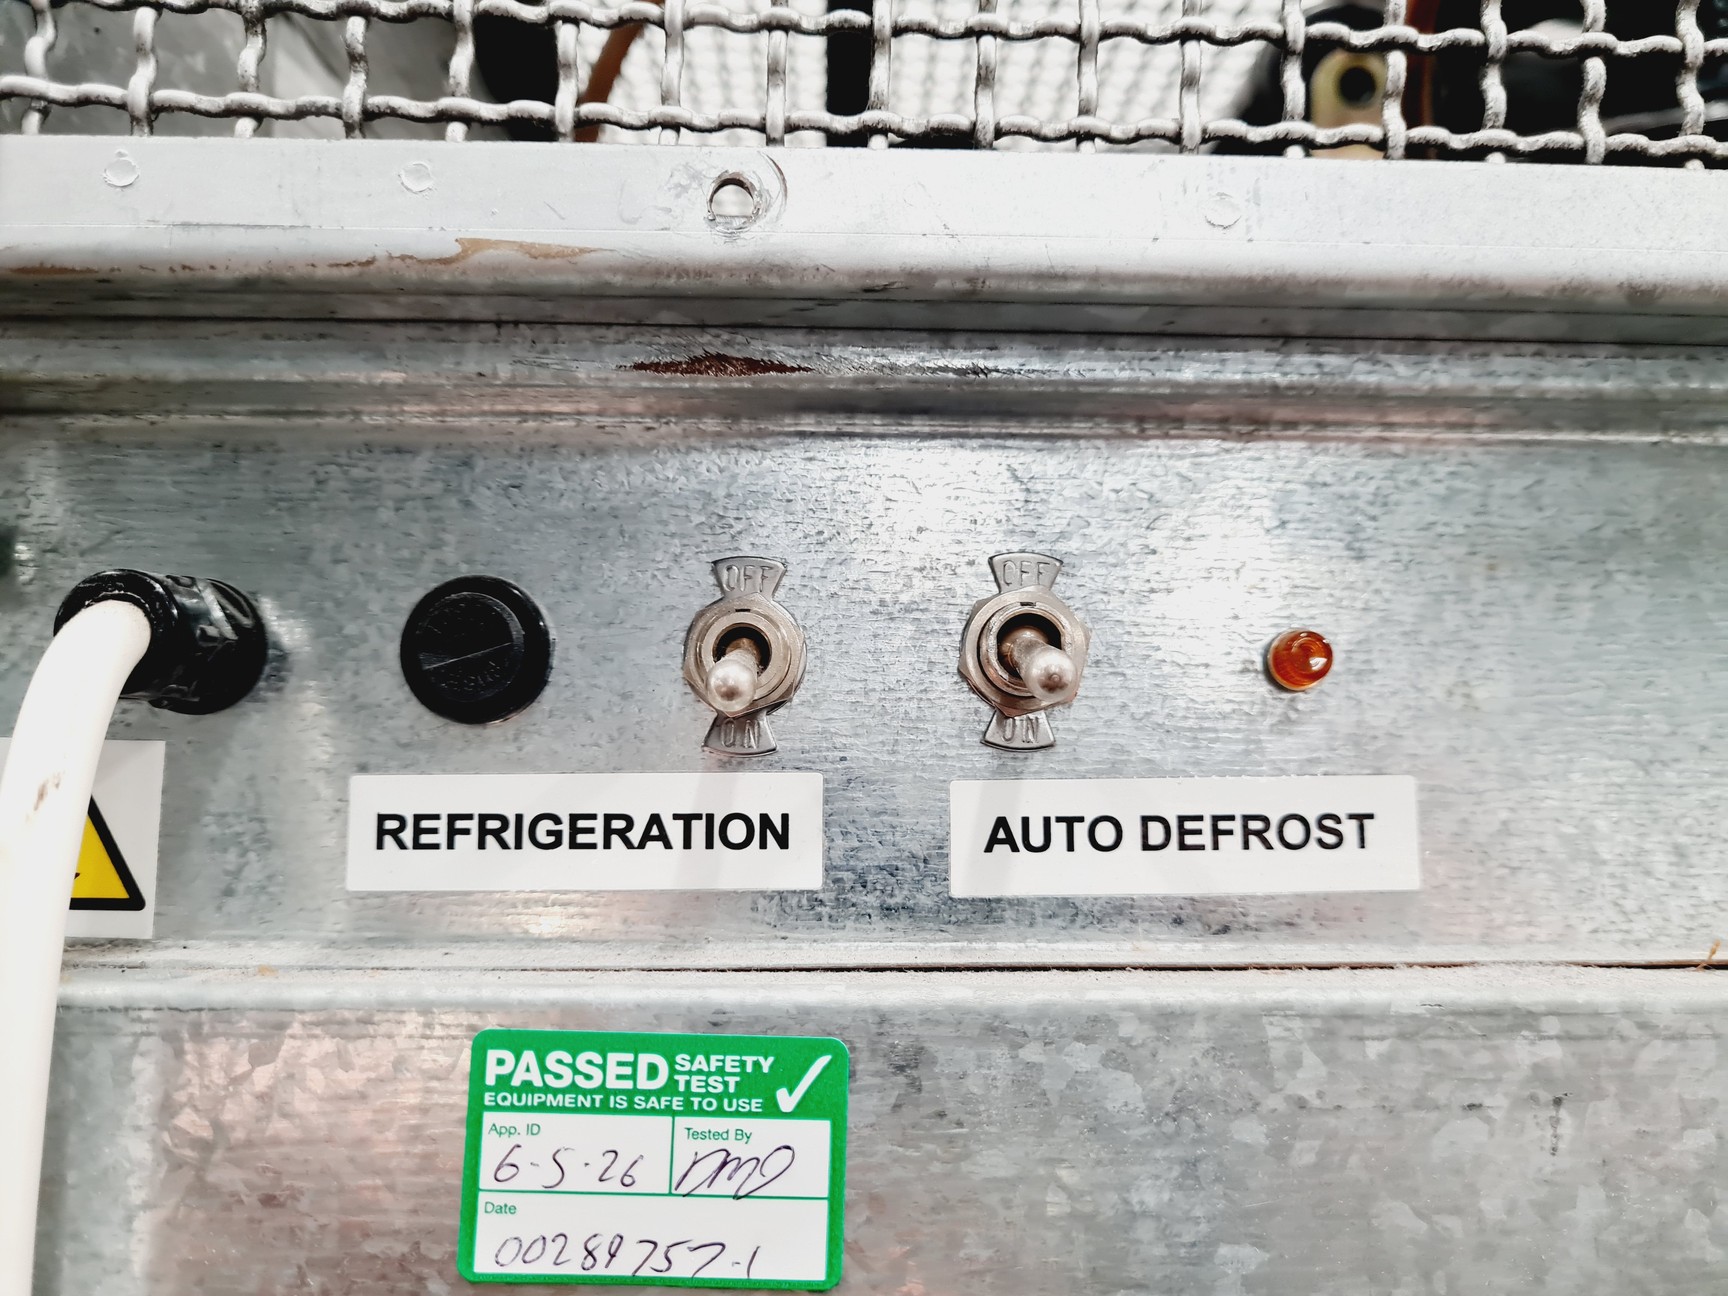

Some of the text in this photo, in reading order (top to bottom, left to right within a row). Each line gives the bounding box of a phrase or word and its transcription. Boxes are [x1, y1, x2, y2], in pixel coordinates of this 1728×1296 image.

[724, 565, 774, 592] OFF
[1003, 560, 1051, 587] OFF
[720, 719, 760, 749] ON
[1002, 716, 1040, 744] ON
[375, 812, 790, 850] REFRIGERATION
[984, 813, 1375, 853] AUTO DEFROST
[485, 1049, 774, 1090] PASSED SAFETY
[673, 1075, 740, 1093] TEST
[484, 1092, 763, 1112] EQUIPMENT IS SAFE TO USE
[488, 1123, 541, 1138] App. ID
[684, 1127, 753, 1144] Tested By
[484, 1201, 517, 1215] Date
